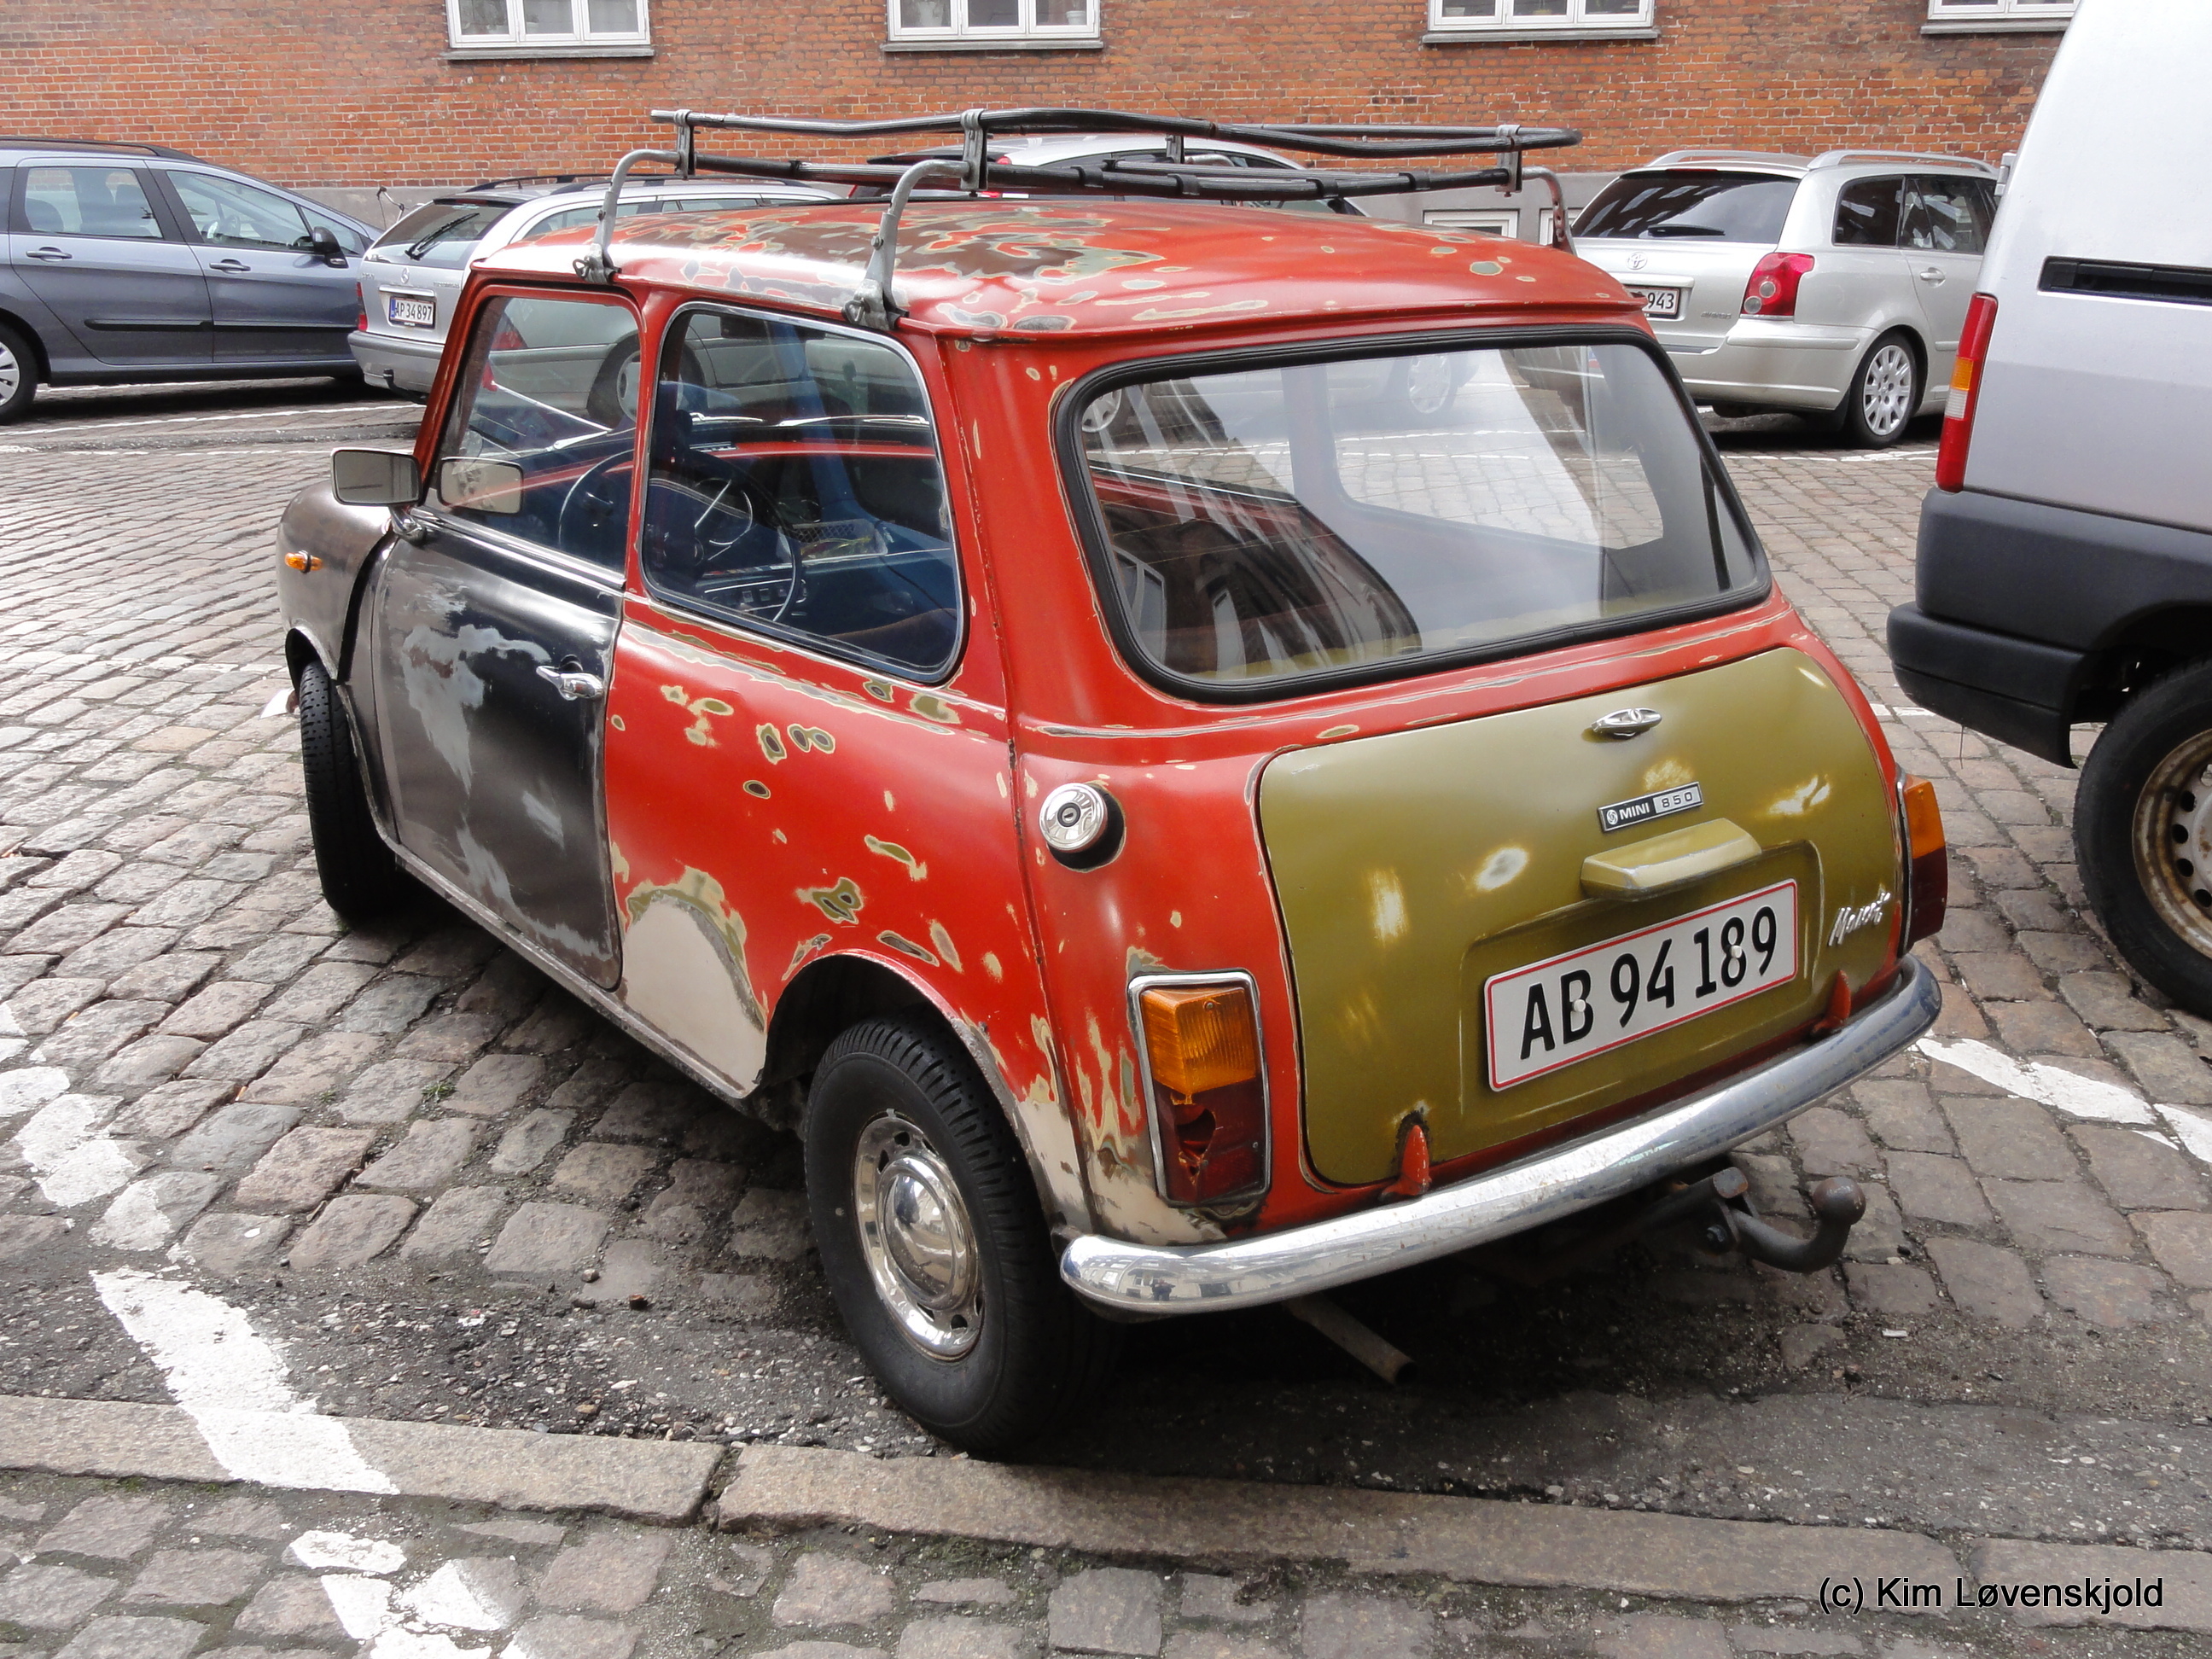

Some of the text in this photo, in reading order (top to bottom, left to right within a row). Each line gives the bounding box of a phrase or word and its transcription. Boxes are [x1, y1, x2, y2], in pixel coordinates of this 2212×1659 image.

[394, 302, 432, 321] AP 34 897
[1647, 292, 1674, 309] 943
[1619, 792, 1693, 820] MINI 850
[1520, 905, 1778, 1061] AB 94 189
